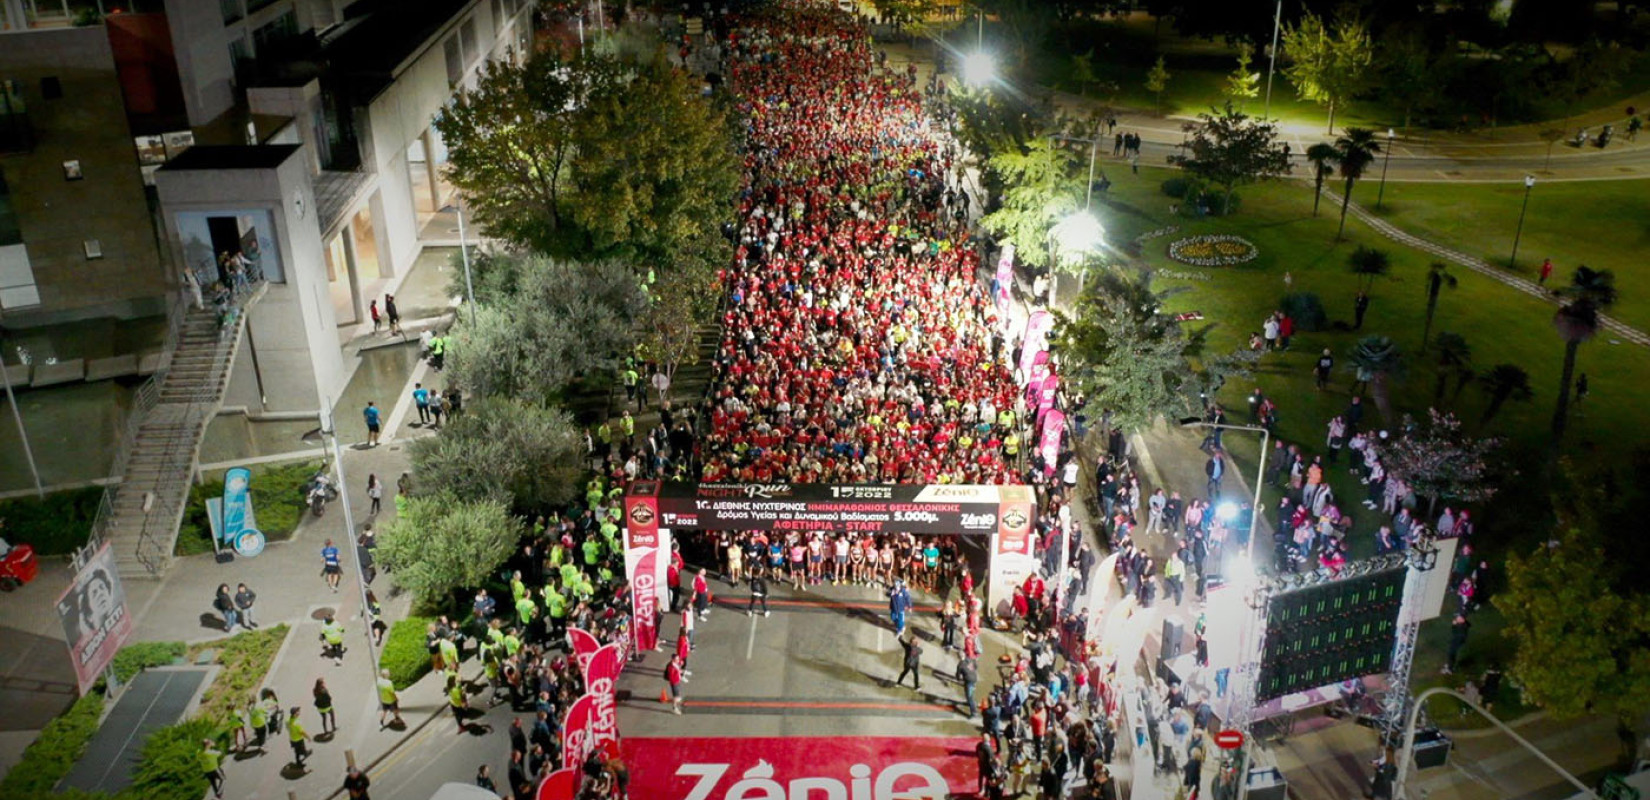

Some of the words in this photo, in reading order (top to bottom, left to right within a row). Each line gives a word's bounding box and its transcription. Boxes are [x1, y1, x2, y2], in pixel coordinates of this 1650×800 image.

[744, 483, 791, 498] Run
[830, 486, 854, 498] 15
[712, 501, 751, 511] ΔΙΕΘΝΗΣ
[752, 502, 806, 511] ΝΥΧΤΕΡΙΝΟΣ
[889, 503, 960, 512] ΘΕΣΣΑΛΟΝΙΚΗΣ
[716, 510, 748, 520] Δρόμος
[750, 510, 777, 520] Υγείας
[779, 512, 793, 520] και
[794, 511, 838, 521] Δυναμικού
[893, 511, 939, 523] 5.000μ.
[773, 520, 833, 531] ΑΦΕΤΗΡΙΑ
[846, 521, 883, 531] START
